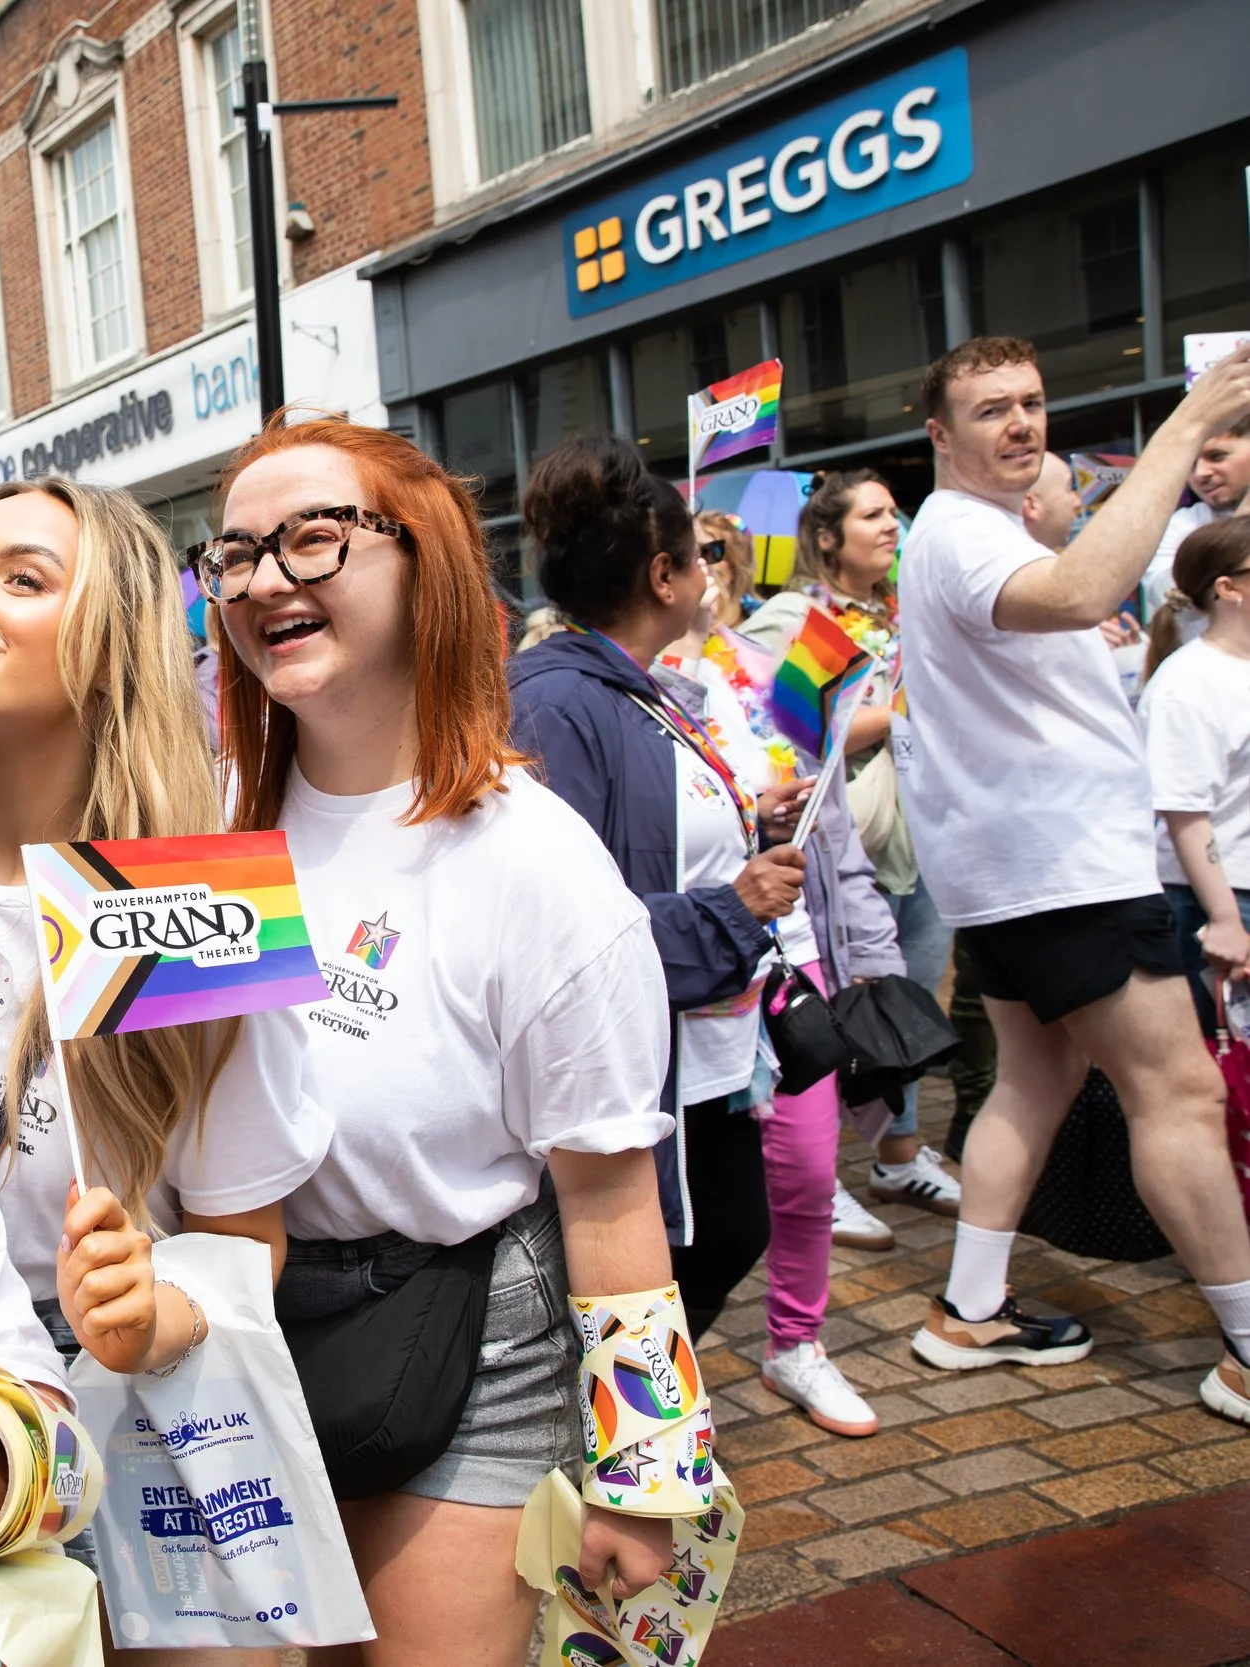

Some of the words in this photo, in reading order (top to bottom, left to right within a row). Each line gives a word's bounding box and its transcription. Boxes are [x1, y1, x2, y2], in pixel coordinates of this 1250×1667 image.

[634, 86, 942, 264] GREGGS
[701, 399, 758, 432] GRAND
[21, 388, 174, 481] co-operative
[93, 891, 208, 909] WOLVERHAMPTON
[89, 902, 255, 950] GRAND
[198, 945, 253, 960] THEATRE
[322, 961, 379, 985] WOLVERHAMPTON
[308, 1009, 370, 1041] everyone
[327, 1010, 350, 1022] THEATRE
[351, 1017, 363, 1026] FOR
[355, 1005, 387, 1022] THEATRE
[641, 1337, 681, 1405] GRAND
[223, 1412, 250, 1428] UK
[188, 1437, 232, 1456] ENTERTAINMENT
[232, 1434, 255, 1442] CENTRE
[163, 1512, 182, 1531] AT
[211, 1505, 268, 1542] BEST!!
[161, 1545, 176, 1553] Get
[176, 1543, 207, 1554] bowled
[237, 1545, 250, 1556] the
[249, 1535, 279, 1553] family
[175, 1610, 251, 1622] SUPERBOWLUK.CO.UK
